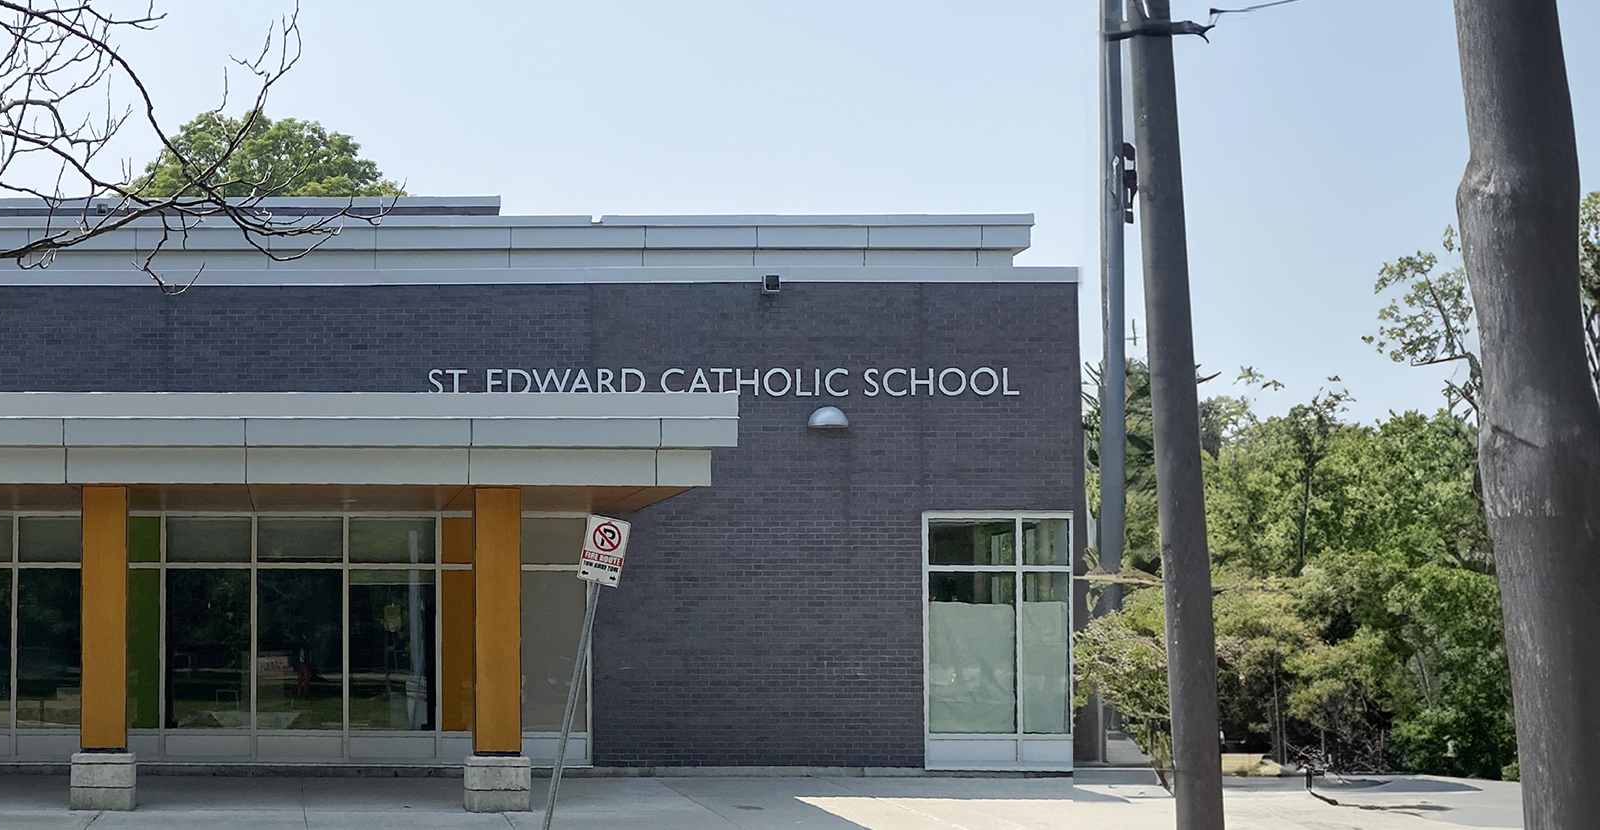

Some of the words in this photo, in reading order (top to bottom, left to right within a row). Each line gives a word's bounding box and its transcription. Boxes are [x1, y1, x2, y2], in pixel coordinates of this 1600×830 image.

[428, 369, 469, 393] ST
[486, 368, 646, 393] EDWARD
[660, 367, 849, 396] CATHOLIC
[863, 367, 1020, 396] SCHOOL
[584, 551, 598, 560] FIRE
[599, 554, 620, 565] ROUTE
